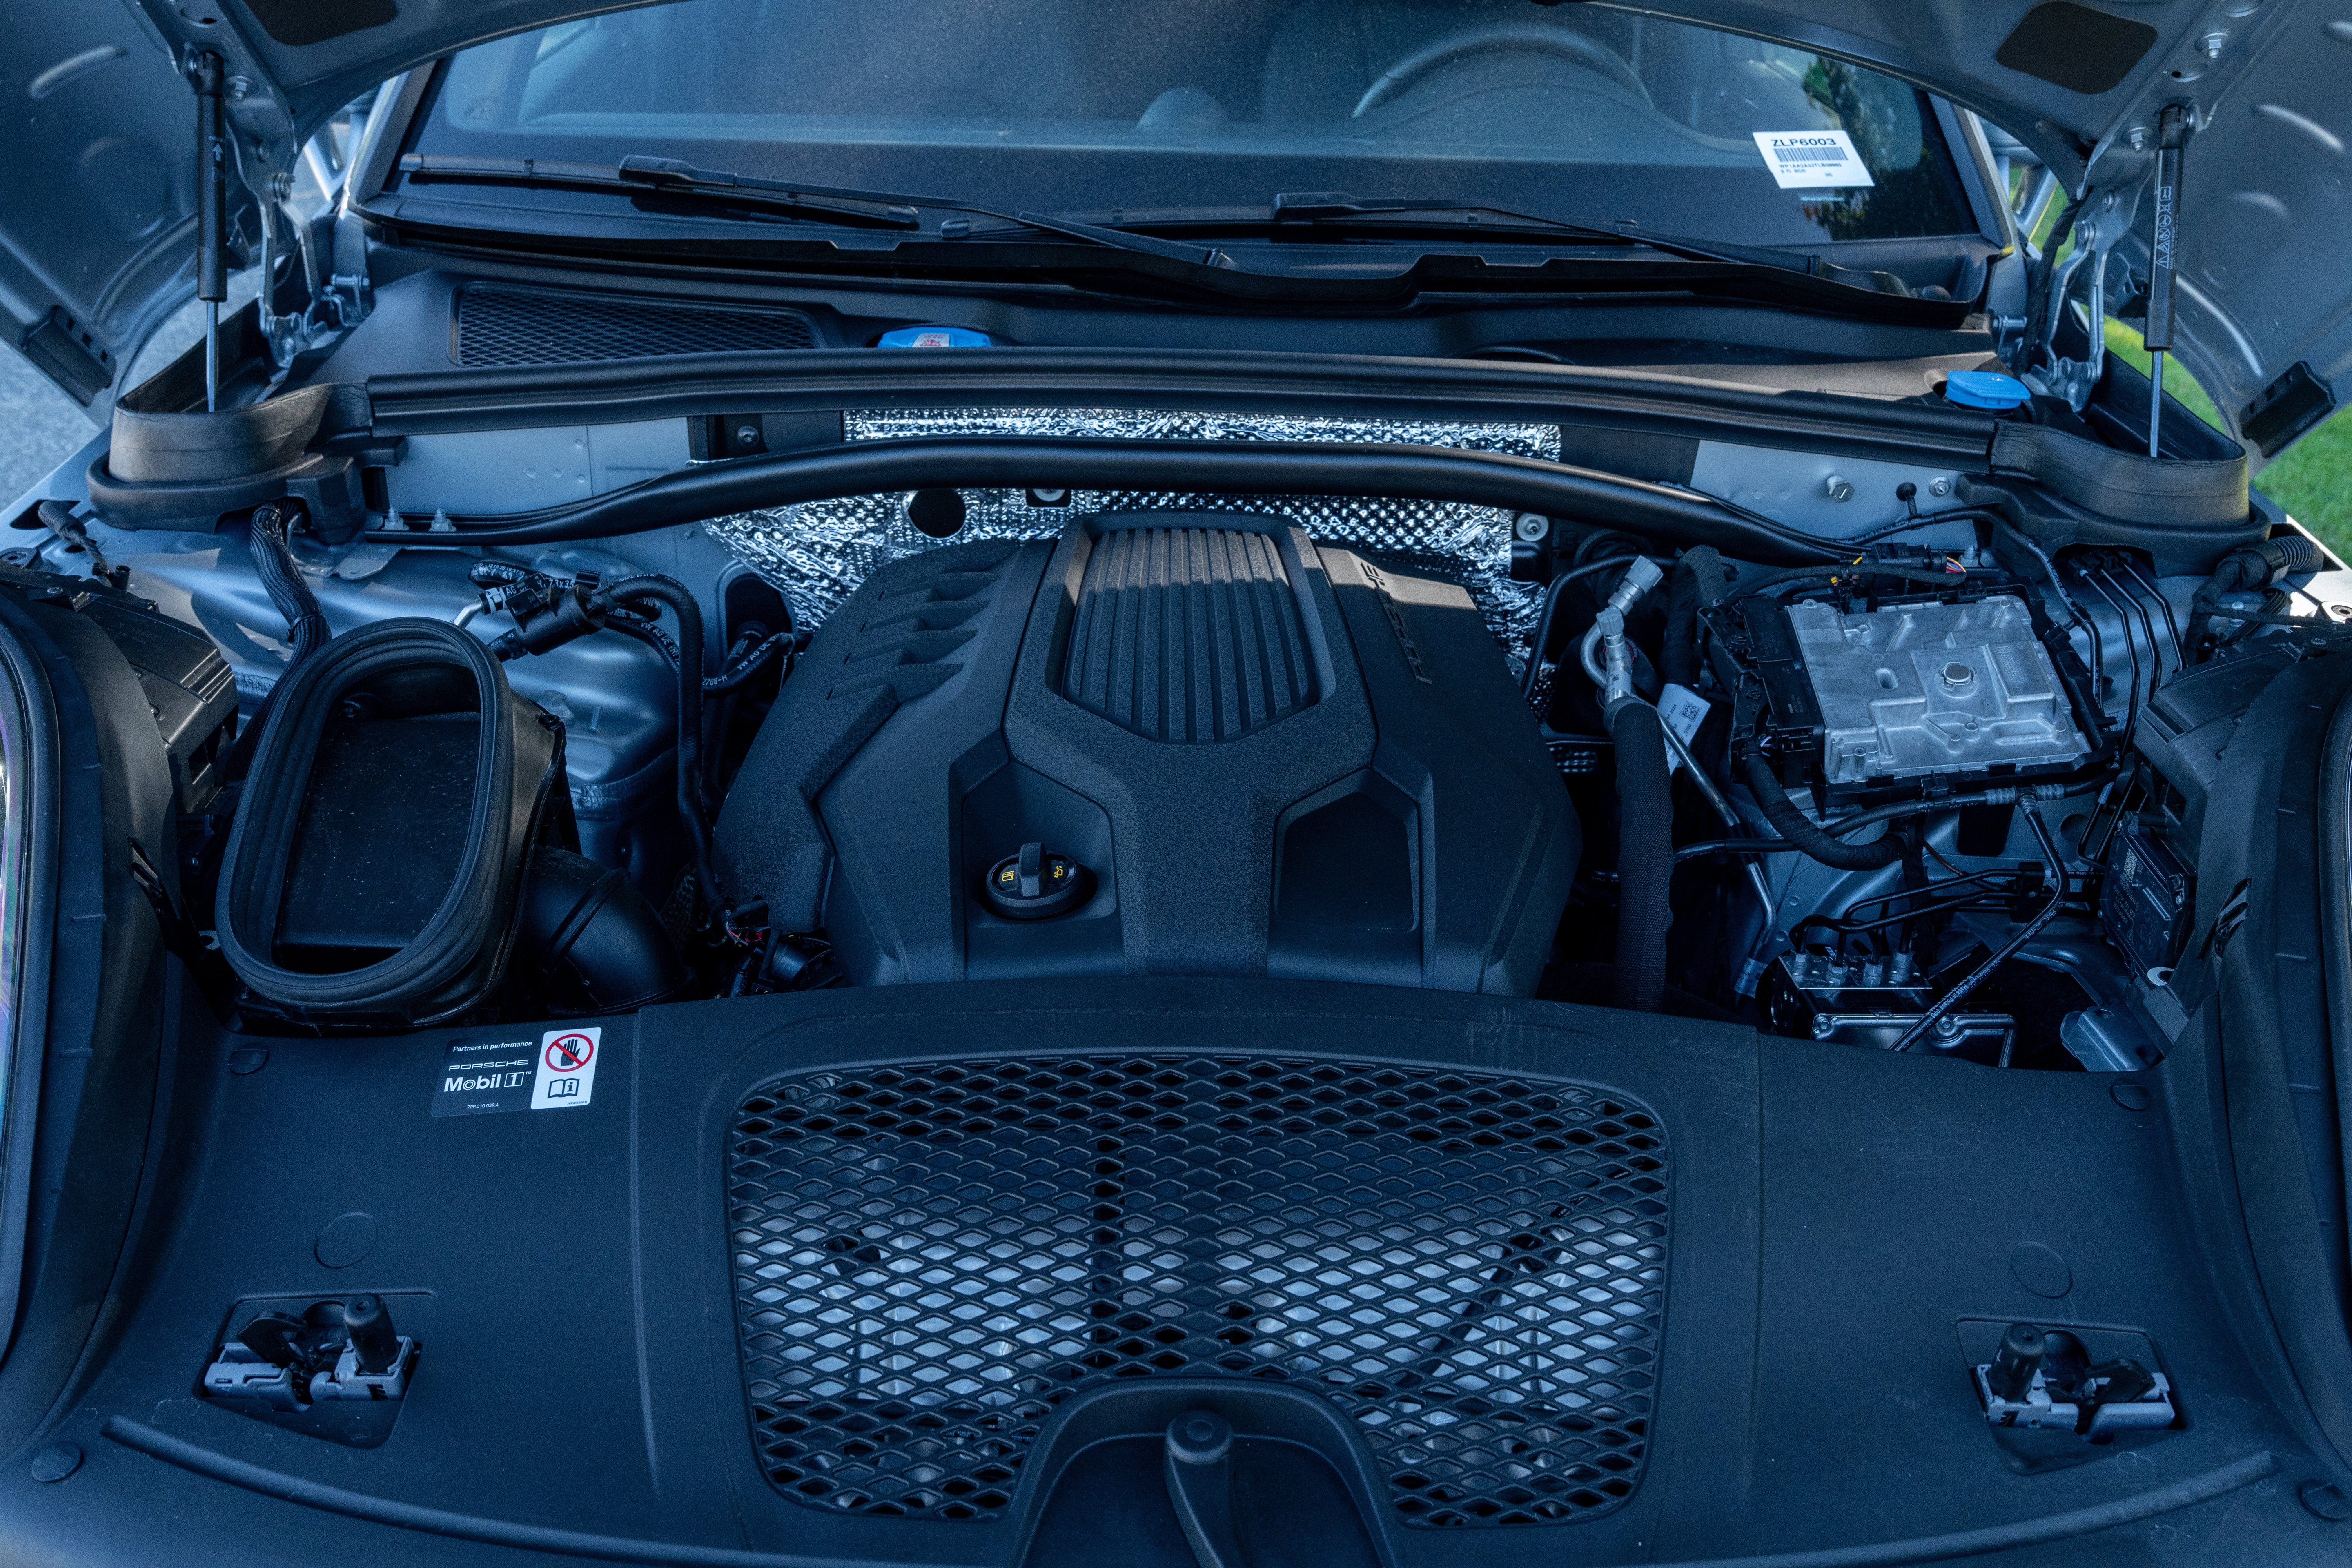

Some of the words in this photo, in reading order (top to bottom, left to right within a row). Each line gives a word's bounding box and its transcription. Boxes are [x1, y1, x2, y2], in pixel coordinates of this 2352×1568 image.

[1771, 138, 1837, 147] ZLP6003
[506, 585, 517, 596] AG
[641, 622, 653, 631] VW
[652, 626, 663, 637] AG
[661, 635, 672, 646] DE
[737, 661, 748, 670] VW
[749, 651, 760, 661] AG
[759, 642, 771, 651] DE
[452, 1044, 481, 1052] Partners
[490, 1040, 532, 1051] performance
[448, 1059, 529, 1071] PORSCHE
[443, 1073, 502, 1092] Mobil
